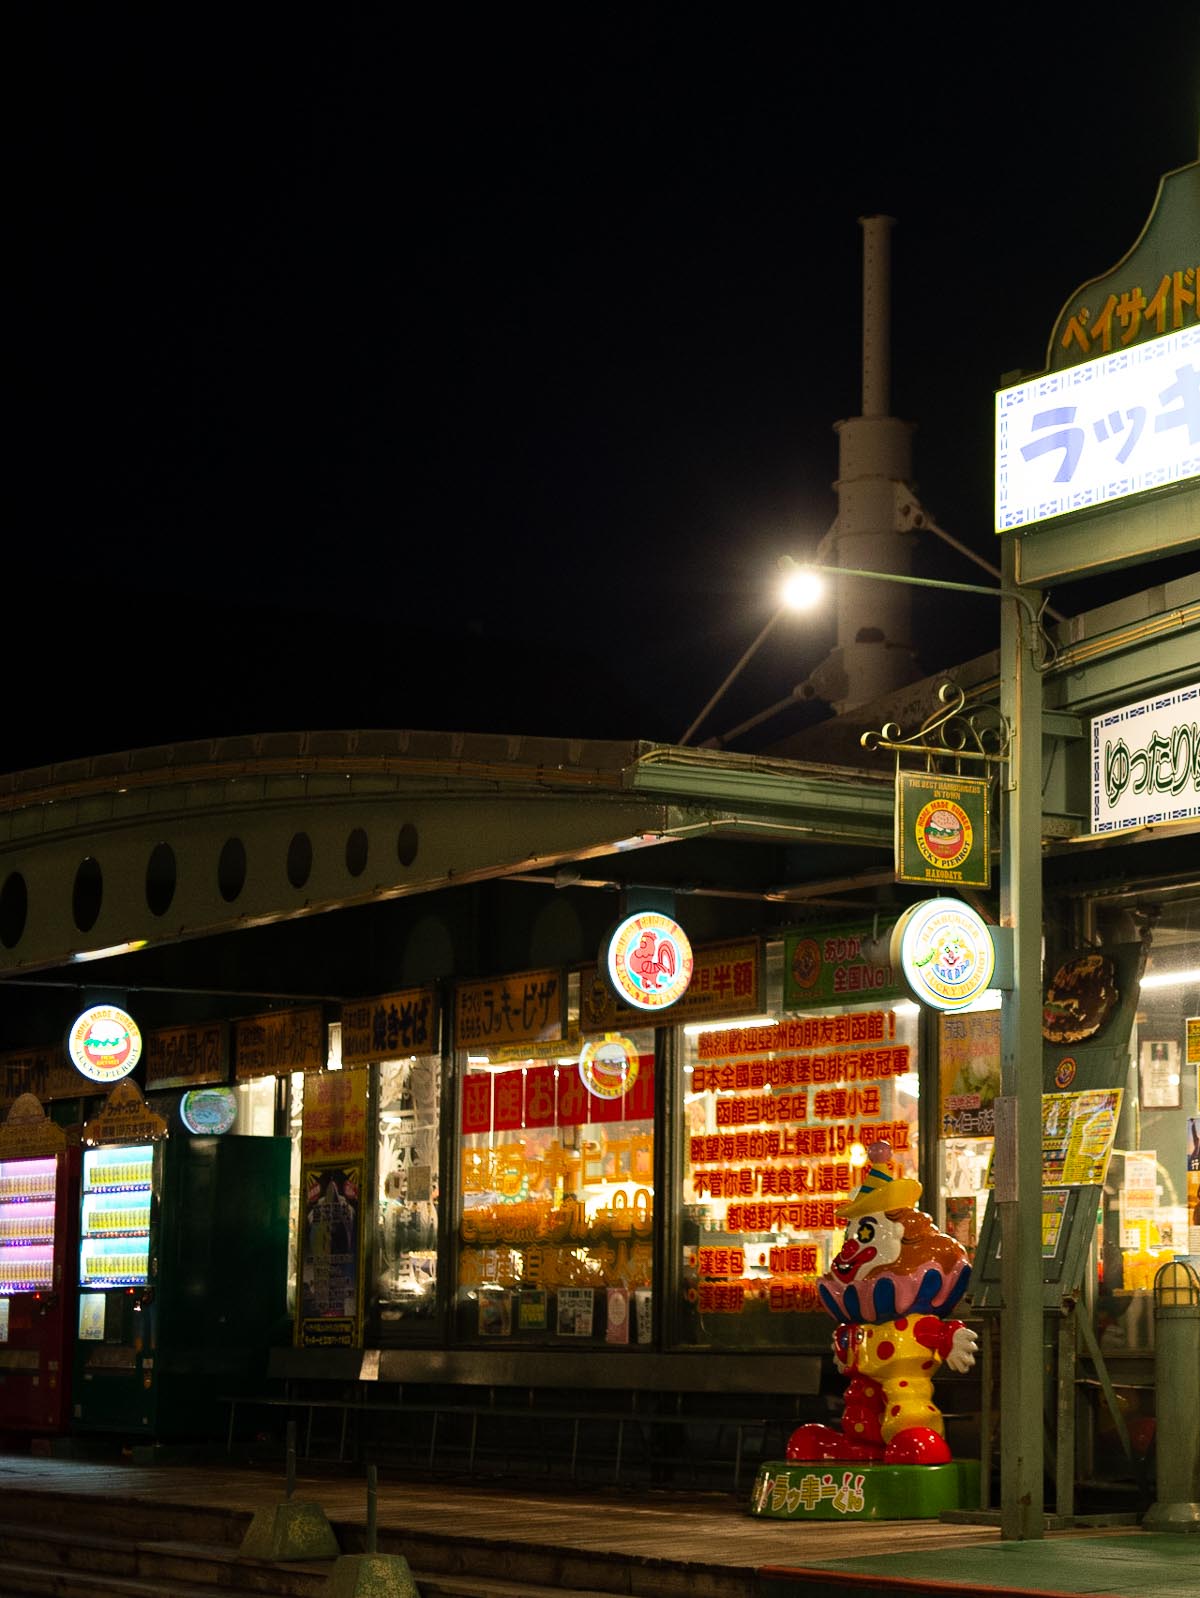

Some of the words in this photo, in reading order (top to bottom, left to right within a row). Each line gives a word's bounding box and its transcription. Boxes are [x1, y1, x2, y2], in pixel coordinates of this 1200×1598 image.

[918, 836, 938, 865] LUCKY
[941, 840, 970, 867] PIERROT
[814, 1086, 880, 1119] 幸運小丑
[699, 1247, 744, 1275] 漢堡包
[769, 1281, 824, 1313] 日式炒
